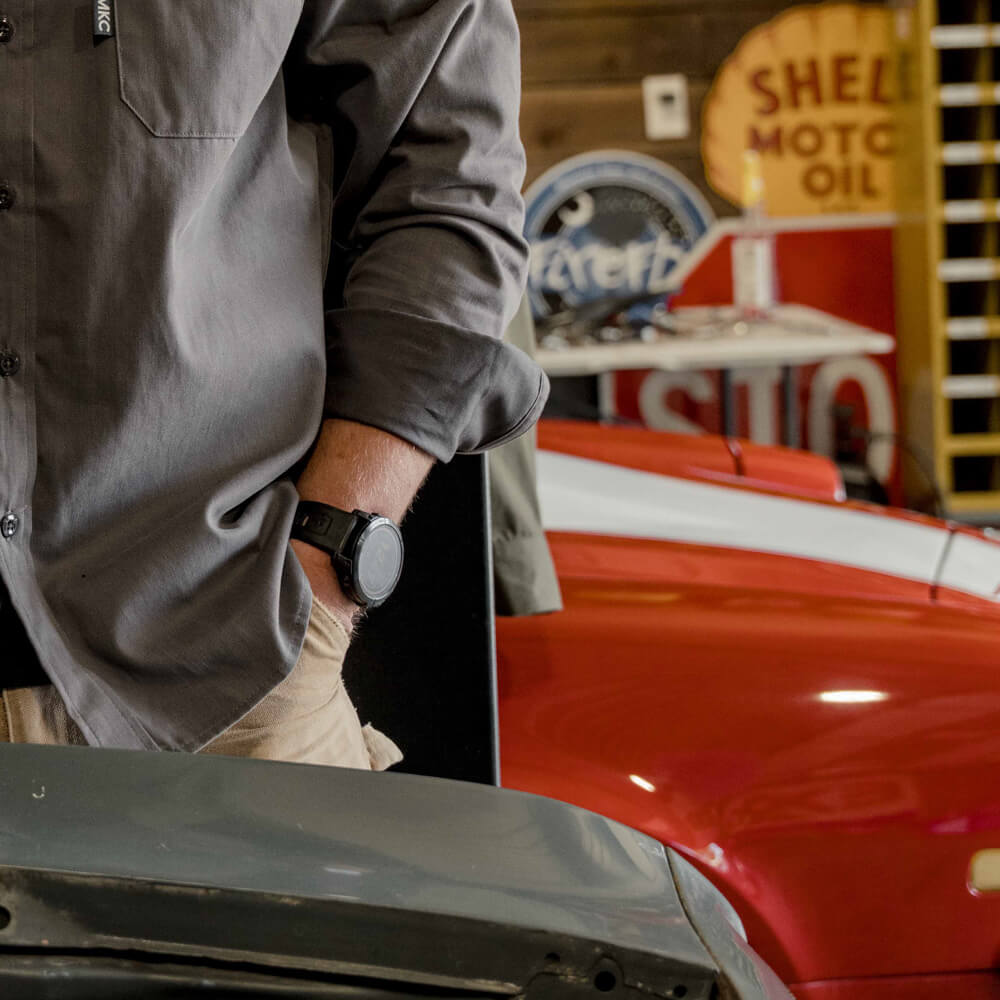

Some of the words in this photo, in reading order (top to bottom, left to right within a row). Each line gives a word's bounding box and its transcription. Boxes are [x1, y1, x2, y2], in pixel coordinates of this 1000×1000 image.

[751, 56, 895, 116] SHEL
[750, 122, 896, 157] MOTO
[803, 163, 879, 199] OIL
[638, 354, 895, 482] STO
